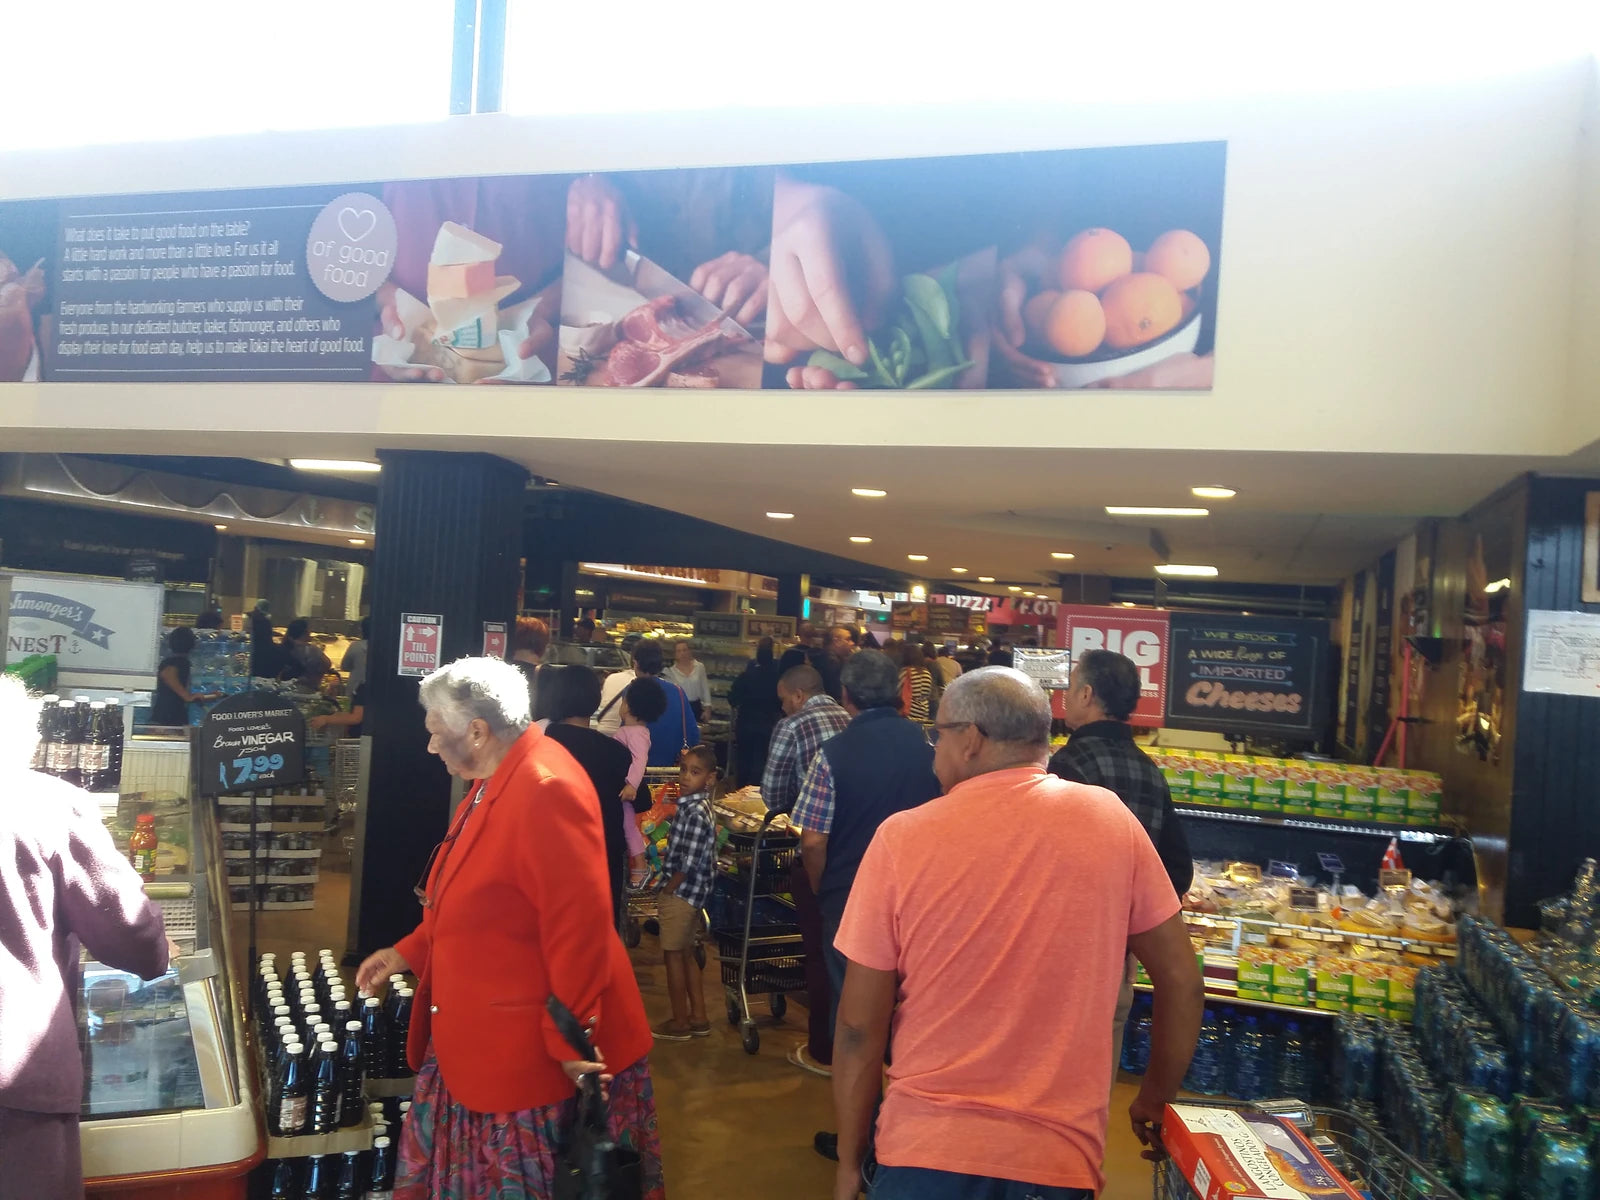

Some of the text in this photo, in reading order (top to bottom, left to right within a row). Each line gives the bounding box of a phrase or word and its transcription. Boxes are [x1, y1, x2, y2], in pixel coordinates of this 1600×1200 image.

[312, 240, 390, 267] of good
[323, 264, 368, 287] food
[945, 595, 991, 611] PIZZA
[7, 634, 67, 654] NEST
[1203, 631, 1279, 642] WE STOCK
[412, 642, 428, 652] TILL
[1071, 627, 1161, 667] BIG
[1188, 650, 1198, 659] A
[1200, 650, 1233, 659] WIDE
[1268, 651, 1287, 659] OF
[404, 652, 436, 664] POINTS
[1199, 665, 1287, 680] IMPORTED
[1185, 680, 1302, 713] Cheeses
[211, 709, 293, 721] FOOD LOVER'S MARKET
[213, 731, 296, 749] Brown VINEGAR
[1231, 1138, 1277, 1191] LANGOSTINOS
[1246, 1139, 1285, 1187] CONGELADOS
